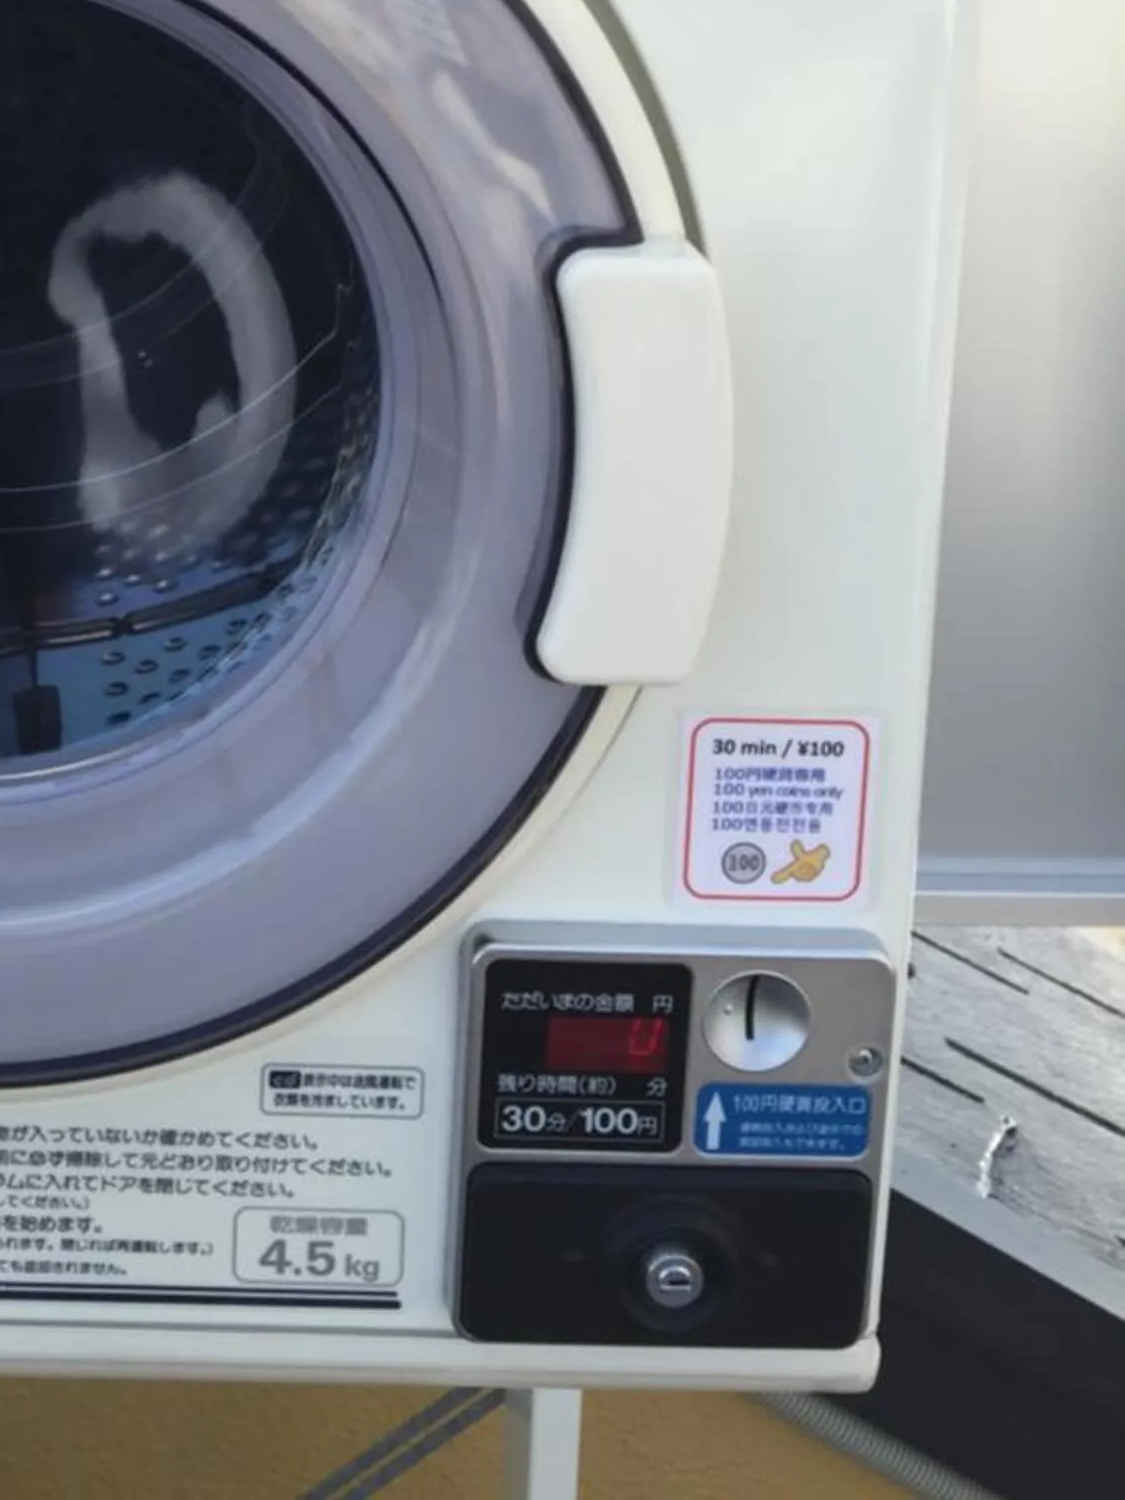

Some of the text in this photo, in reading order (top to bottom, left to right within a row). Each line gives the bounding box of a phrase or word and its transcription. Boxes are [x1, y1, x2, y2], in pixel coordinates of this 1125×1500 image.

[713, 738, 845, 760] 30 min / ¥100
[714, 783, 745, 796] 100
[728, 855, 761, 872] 100
[501, 990, 674, 1014] ただいまの金額 円
[646, 1077, 668, 1097] 分
[732, 1093, 868, 1115] 100円硬貨投入口
[269, 1214, 369, 1236] 乾燥容量
